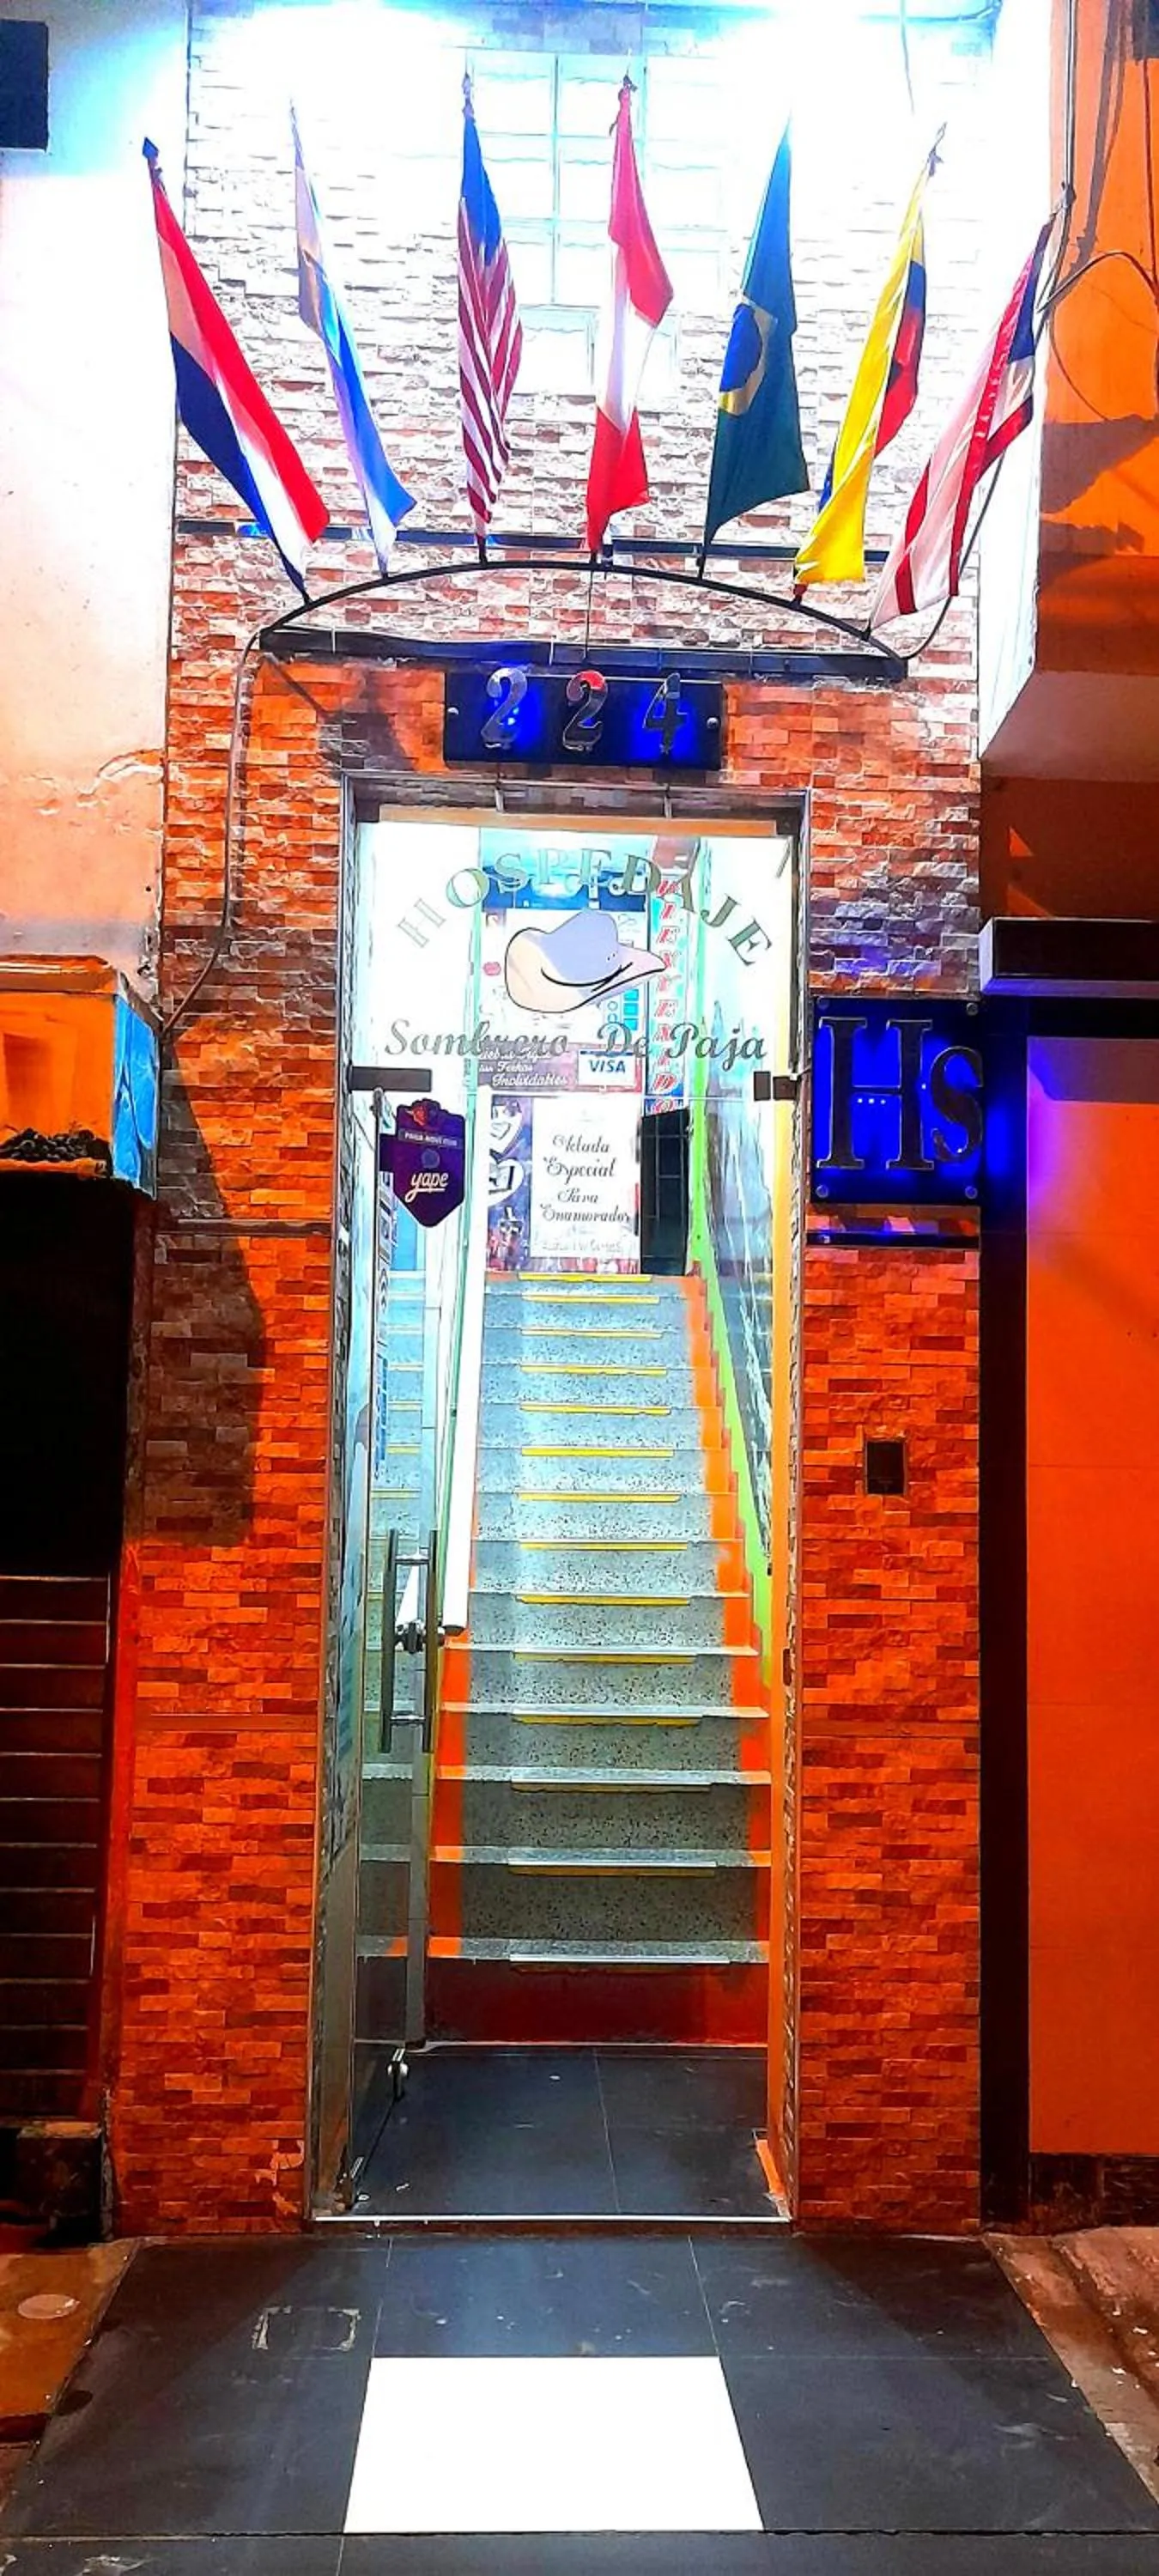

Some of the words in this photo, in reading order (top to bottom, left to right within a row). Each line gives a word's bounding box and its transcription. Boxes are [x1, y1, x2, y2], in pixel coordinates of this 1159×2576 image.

[481, 666, 689, 753] 224
[397, 848, 774, 968] HOSPEDAJE
[385, 1018, 569, 1057] Sombrero
[597, 1021, 652, 1058] De
[664, 1023, 767, 1072] Paja
[588, 1060, 627, 1074] VISA
[816, 1017, 983, 1170] Hs
[404, 1171, 449, 1203] yape
[543, 1156, 617, 1185] Especial
[557, 1187, 599, 1204] Para
